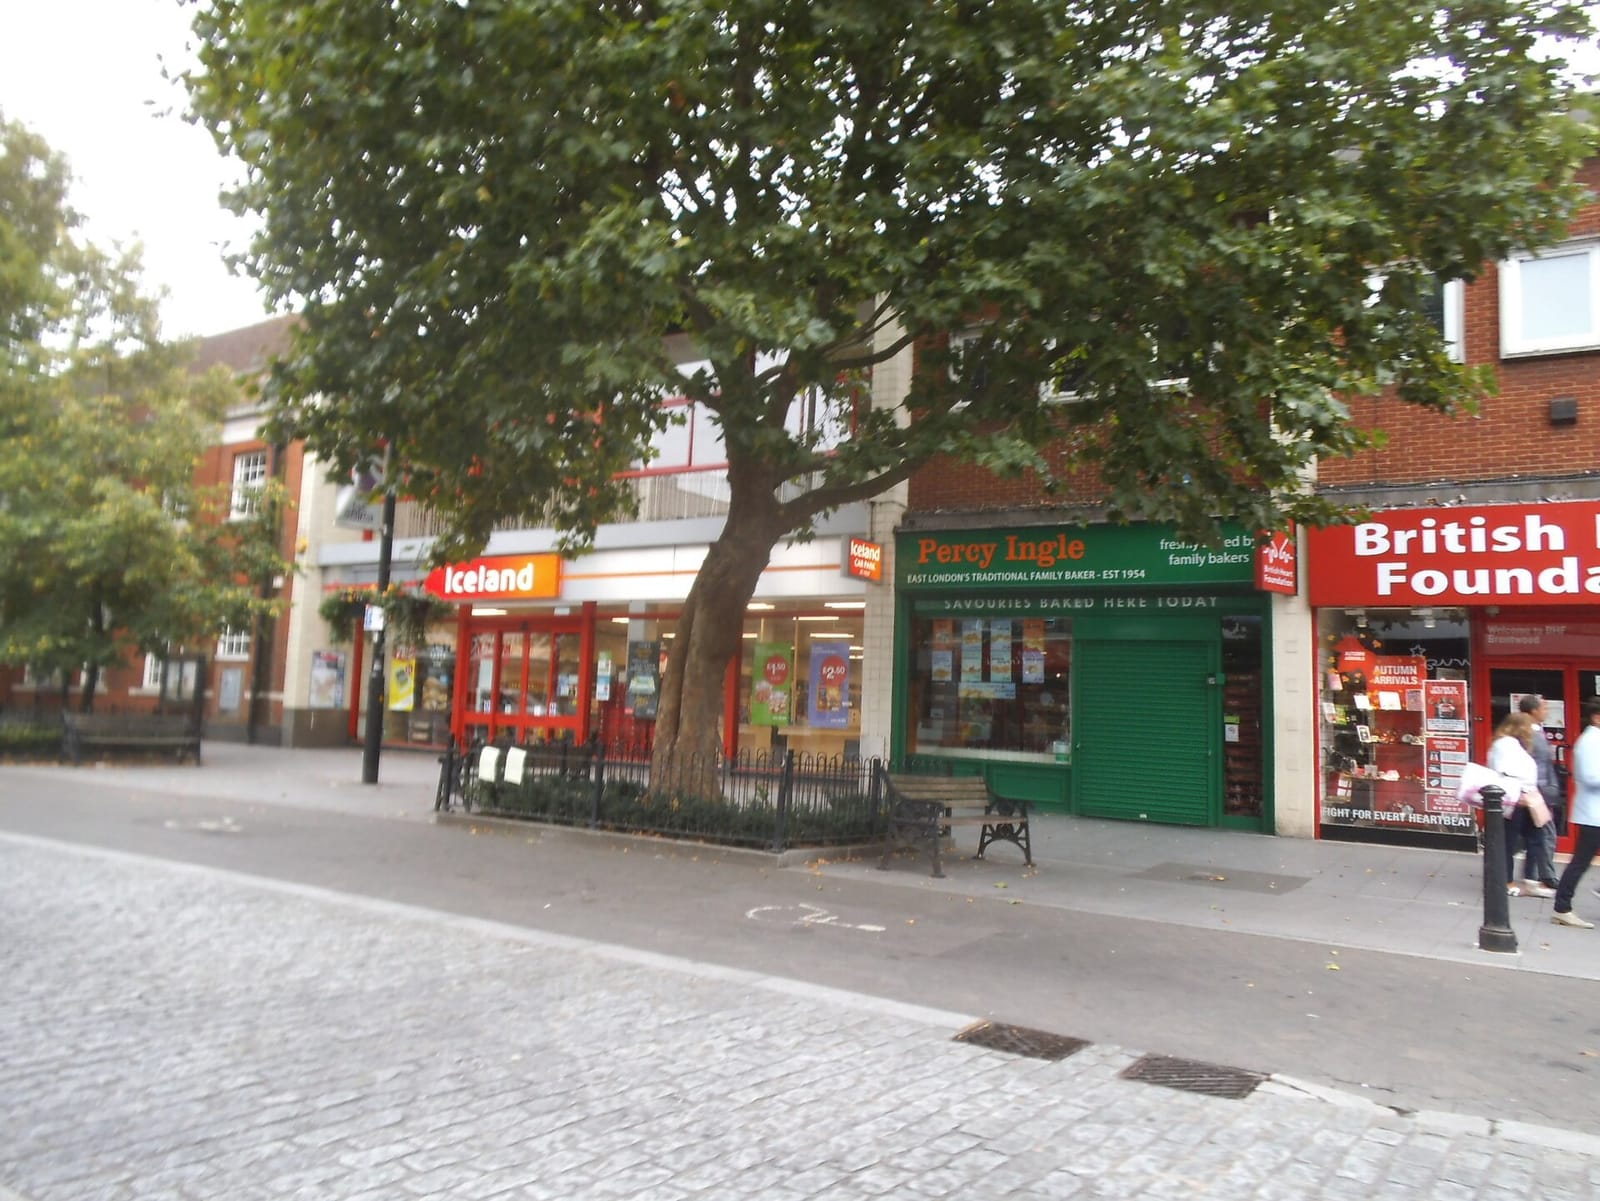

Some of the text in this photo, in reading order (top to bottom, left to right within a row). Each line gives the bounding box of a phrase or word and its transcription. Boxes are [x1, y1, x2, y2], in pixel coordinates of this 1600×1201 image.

[1354, 514, 1566, 557] British
[850, 539, 880, 562] Iceland
[918, 533, 1085, 569] Percy Ingle
[1160, 538, 1199, 551] fresy
[1168, 552, 1249, 567] family bakers
[444, 562, 535, 594] Iceland
[907, 574, 928, 584] EAST
[928, 572, 970, 583] LONDON'S
[972, 571, 1028, 582] TRADITIONAL
[1030, 571, 1064, 581] FAMILY
[1065, 570, 1096, 580] BAKER
[1103, 570, 1120, 579] EST
[1122, 569, 1145, 579] 1954
[1264, 574, 1294, 587] Foundation
[944, 597, 1217, 609] SAVOURIES BAKED HERE TODAY
[1373, 665, 1418, 675] AUTUMN
[1373, 675, 1419, 685] ARRIVALS
[1322, 807, 1473, 827] FIGHT FOR EVERY HEARTBEAT
